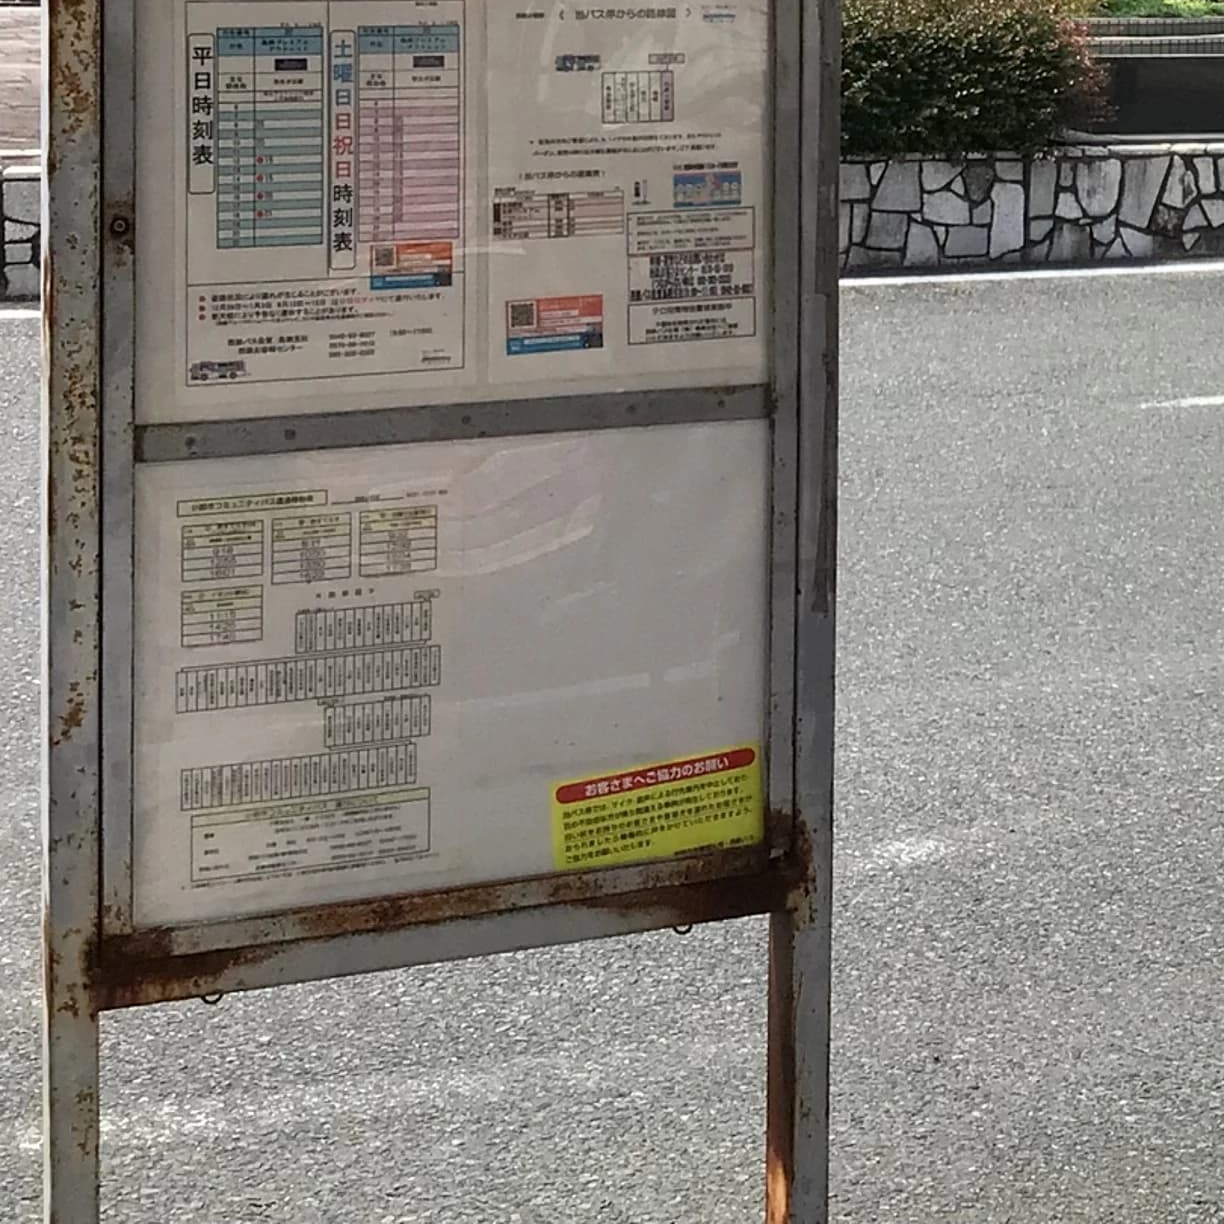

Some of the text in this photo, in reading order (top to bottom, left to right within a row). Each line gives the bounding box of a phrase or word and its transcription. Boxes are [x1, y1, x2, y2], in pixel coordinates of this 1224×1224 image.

[192, 45, 213, 165] 平日時刻表
[585, 757, 729, 797] お客さまへご協力のお願い
